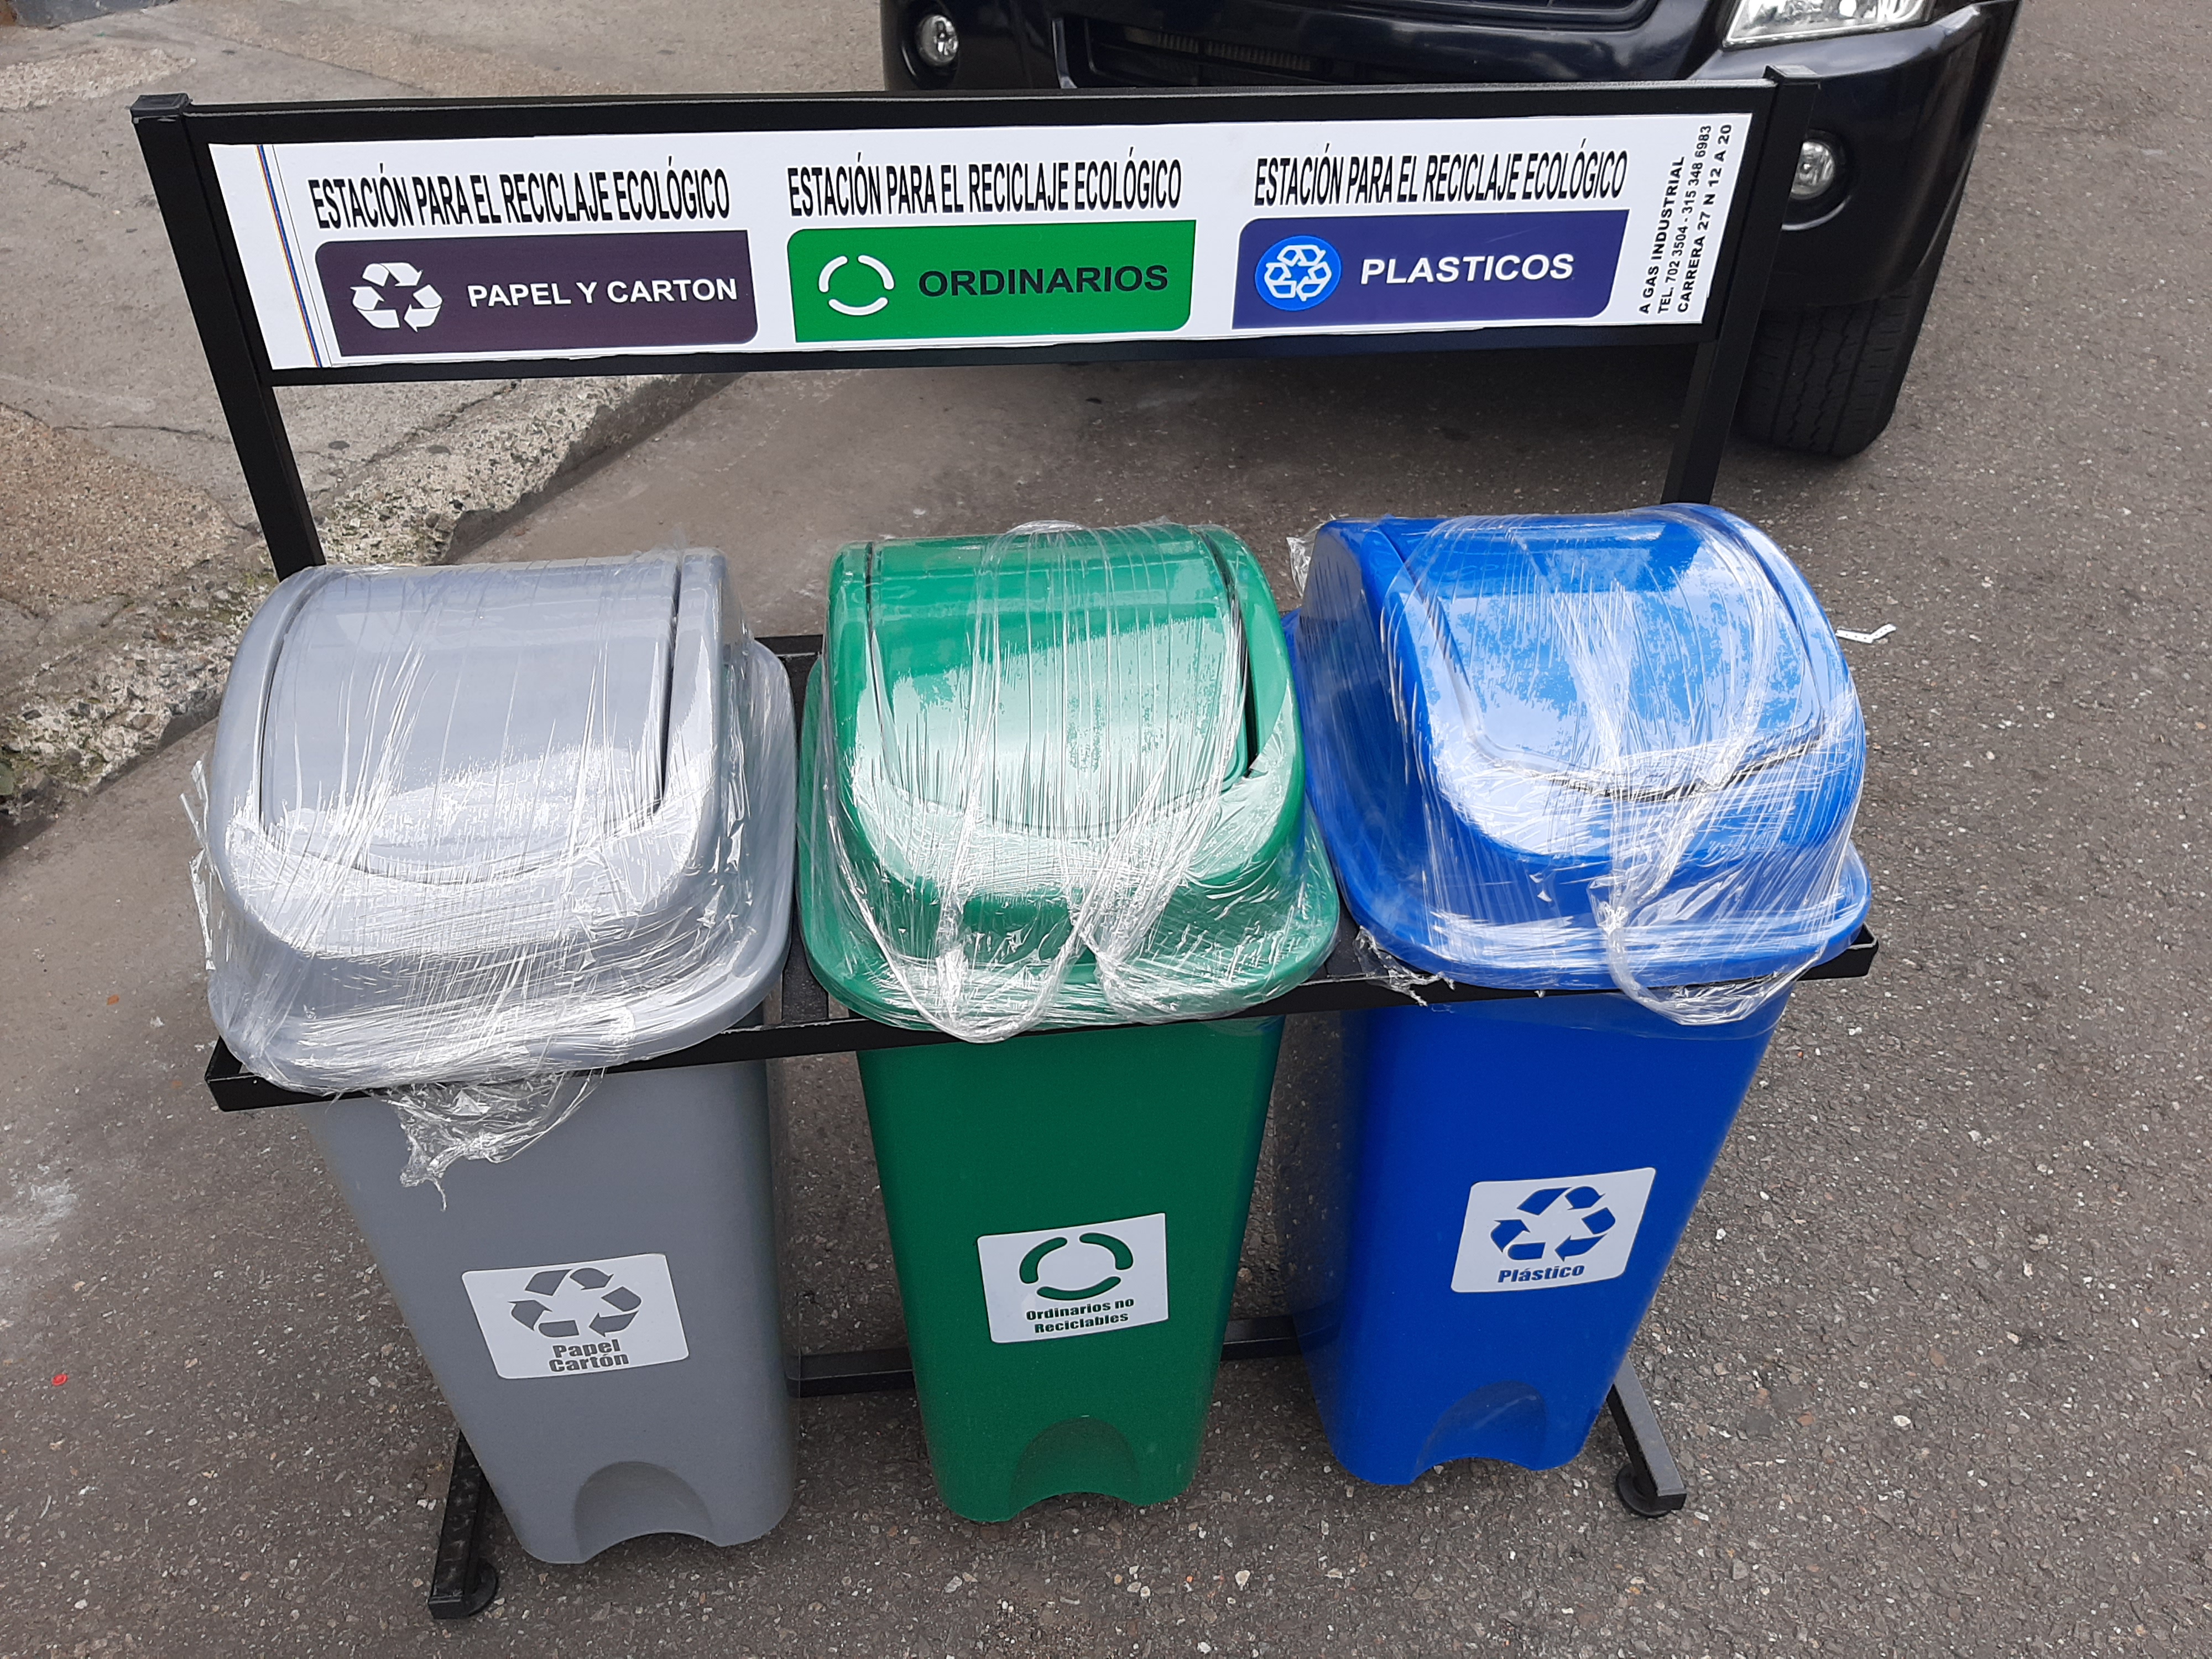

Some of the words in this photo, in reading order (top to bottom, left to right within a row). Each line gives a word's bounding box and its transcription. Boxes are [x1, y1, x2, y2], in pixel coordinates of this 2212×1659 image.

[1695, 126, 1712, 158] 6983
[1718, 124, 1731, 145] 20
[1714, 150, 1726, 163] A
[787, 152, 881, 217] ESTACIÓN
[886, 164, 937, 215] PARA
[940, 164, 964, 213] EL
[968, 161, 1068, 212] RECICLAJE
[1074, 147, 1181, 210] ECOLÓGICO
[1254, 143, 1343, 206] ESTACIÓN
[1346, 155, 1393, 204] PARA
[1396, 155, 1417, 203] EL
[1422, 152, 1522, 202] RECICLAJE
[1521, 138, 1628, 200] ECOLÓGICO
[1688, 161, 1704, 187] 348
[1708, 168, 1721, 187] 12
[307, 163, 414, 229] ESTACIÓN
[412, 174, 472, 226] PARA
[470, 174, 501, 223] EL
[502, 171, 612, 222] RECICLAJE
[613, 155, 729, 220] ECOLÓGICO
[1682, 190, 1697, 214] 315
[1703, 194, 1715, 205] N
[1651, 156, 1684, 259] INDUSTRIAL
[1698, 212, 1711, 231] 27
[1672, 226, 1688, 257] 3504
[918, 264, 1168, 297] ORDINARIOS
[1360, 254, 1574, 284] PLASTICOS
[1643, 265, 1660, 298] GAS
[1666, 260, 1680, 283] 702
[1677, 235, 1705, 312] CARRERA
[467, 283, 571, 307] PAPEL
[576, 281, 598, 304] Y
[607, 278, 738, 304] CARTON
[1658, 287, 1674, 314] TEL.
[1639, 303, 1650, 314] A
[1498, 1265, 1584, 1282] Plástico
[1026, 1301, 1111, 1320] Ordinarios
[1114, 1299, 1134, 1309] no
[1035, 1313, 1129, 1333] Reciclables
[552, 1339, 621, 1358] Papel
[549, 1353, 629, 1372] Cartón
